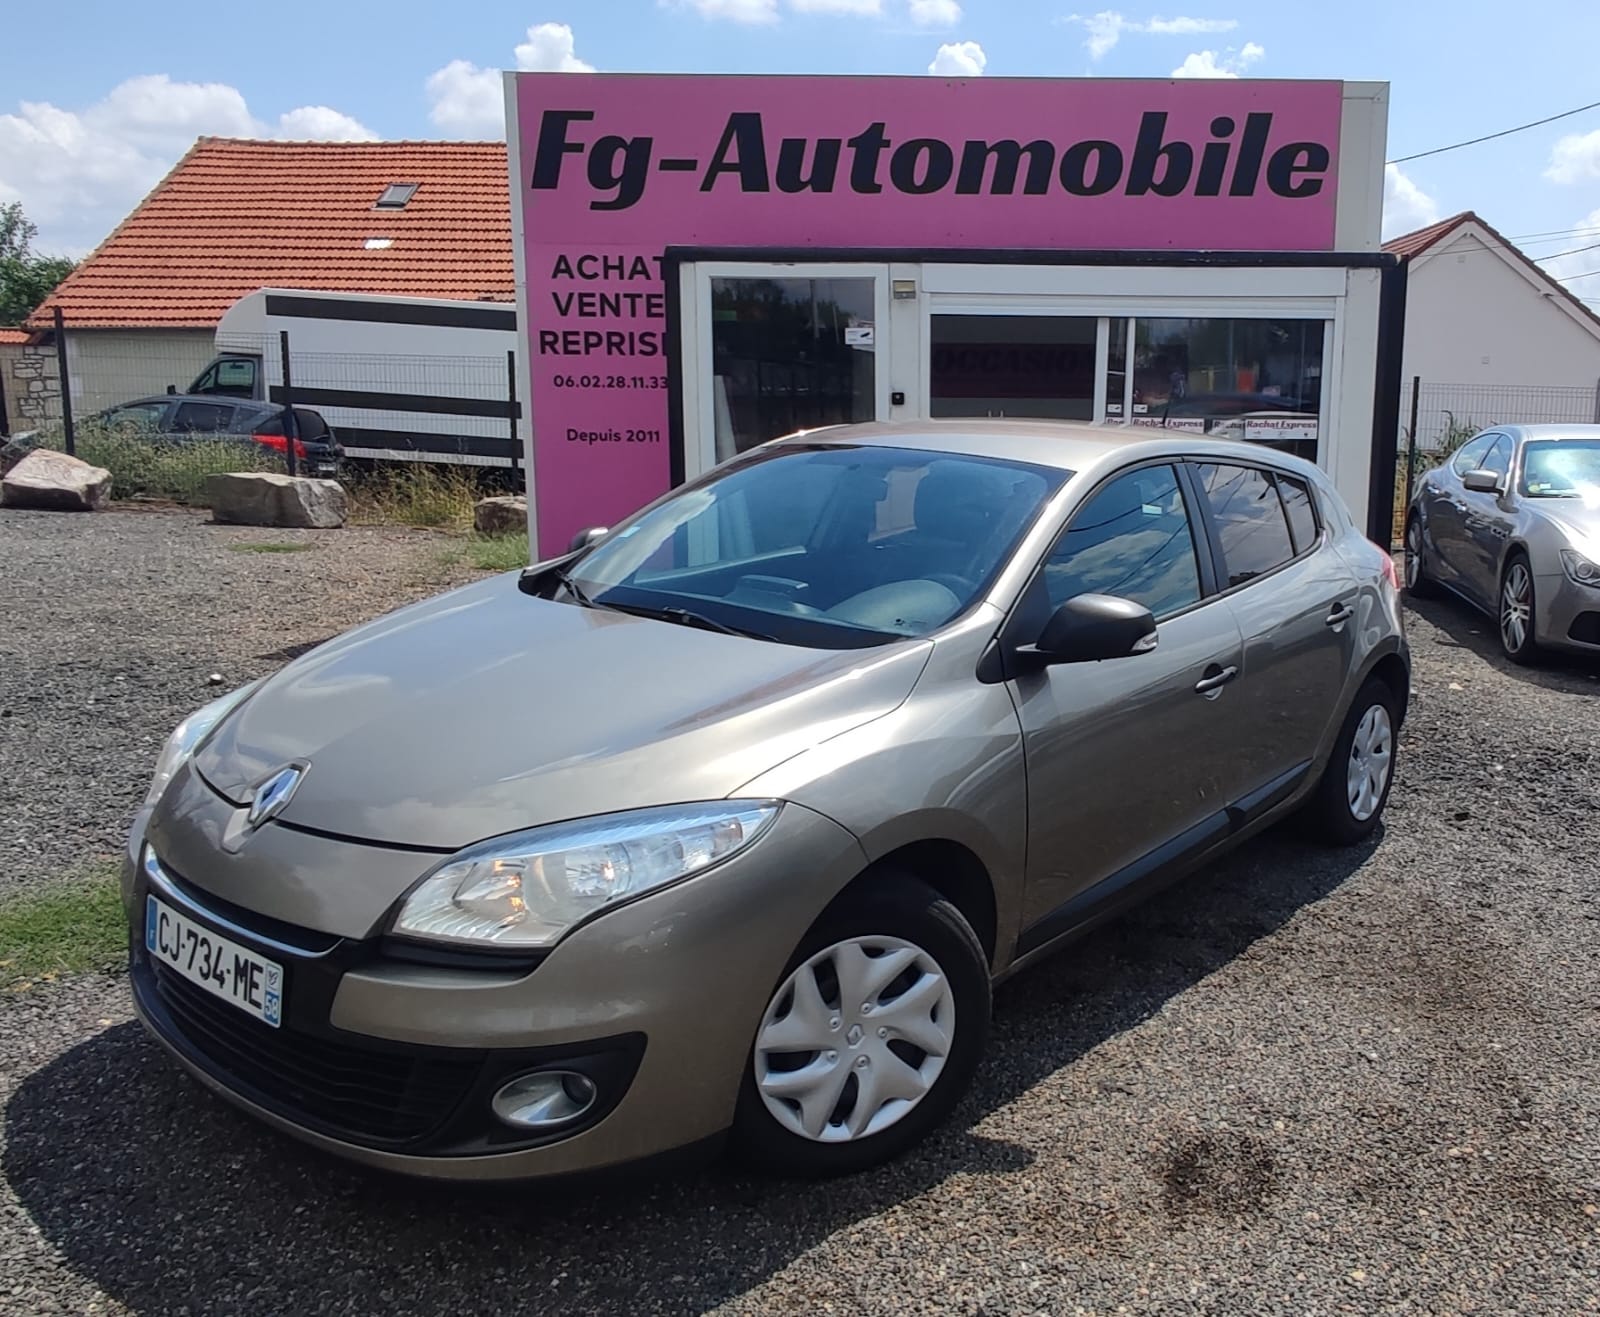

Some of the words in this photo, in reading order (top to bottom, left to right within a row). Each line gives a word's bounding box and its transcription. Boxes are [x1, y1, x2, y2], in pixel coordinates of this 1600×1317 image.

[531, 110, 1330, 210] Fg-Automobile
[551, 292, 664, 318] VENTE
[553, 374, 668, 389] 06.02.28.11.33
[1246, 420, 1279, 429] Rachat
[1280, 420, 1317, 430] Express
[566, 428, 621, 445] Depuis
[626, 429, 660, 443] 2011
[159, 911, 264, 1010] CJ-734-ME
